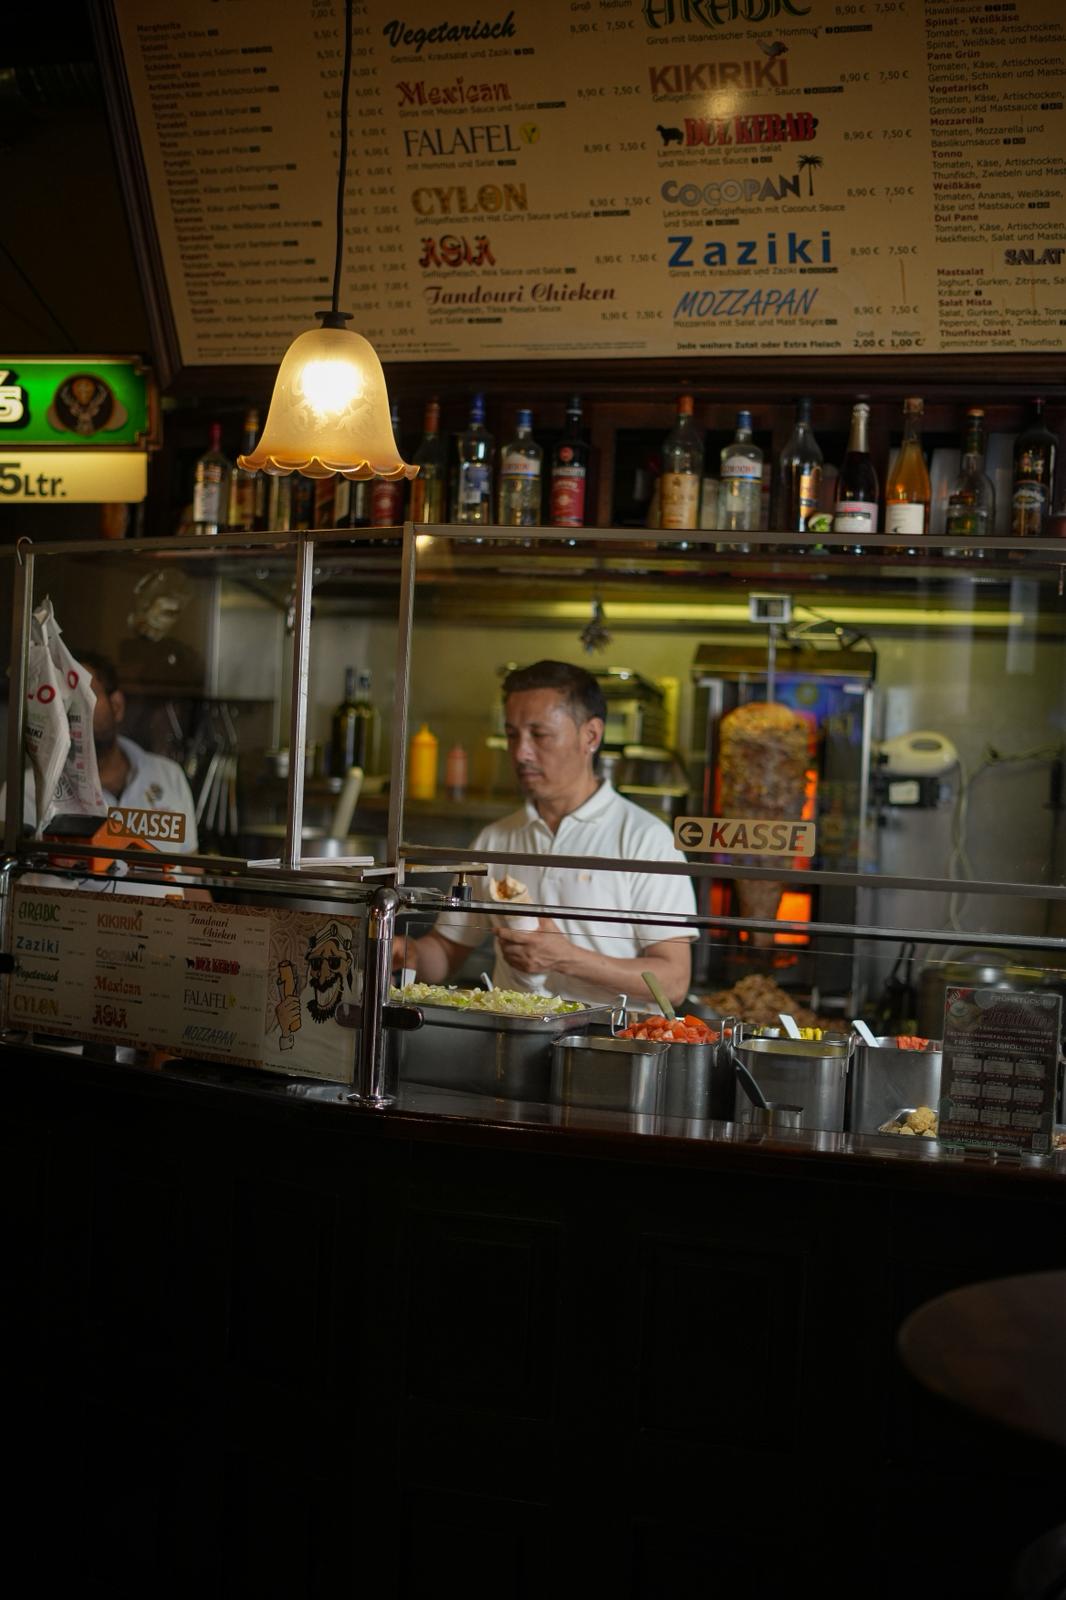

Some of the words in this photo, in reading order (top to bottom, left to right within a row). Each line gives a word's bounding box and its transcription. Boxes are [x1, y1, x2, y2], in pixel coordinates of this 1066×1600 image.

[876, 4, 896, 12] 7,50
[926, 18, 958, 28] Spinat
[970, 14, 1019, 24] Weißkäse
[383, 11, 516, 52] Vegetarisch
[1000, 22, 1062, 34] Artischocken,
[747, 30, 772, 39] Sauce
[1010, 36, 1026, 44] und
[928, 52, 952, 60] Pane
[956, 50, 980, 58] Grün
[1002, 56, 1064, 68] Artischocken,
[650, 58, 788, 94] KIKIRIKI
[880, 72, 900, 81] 7,50
[1016, 69, 1034, 78] und
[396, 76, 512, 107] Mexican
[929, 83, 988, 94] Vegetarisch
[1003, 90, 1064, 100] Artischocken,
[970, 104, 986, 112] und
[990, 102, 1038, 112] Mastsauce
[930, 117, 984, 126] Mozzarella
[734, 112, 818, 144] KEBAB
[976, 125, 1024, 134] Mozzarella
[1027, 124, 1044, 133] und
[866, 131, 874, 140] €
[882, 130, 902, 139] 7,50
[906, 128, 912, 138] €
[404, 124, 521, 157] FALAFEL
[932, 150, 962, 158] Tonno
[982, 170, 1022, 178] Zwiebeln
[1026, 168, 1043, 176] und
[661, 174, 800, 206] COCOPAN
[411, 183, 528, 216] CYLON
[978, 192, 1014, 200] Ananas,
[782, 204, 816, 214] Coconut
[820, 204, 845, 212] Sauce
[958, 202, 975, 210] und
[954, 213, 978, 222] Pane
[992, 233, 1014, 242] Salat
[1018, 232, 1034, 240] und
[668, 231, 832, 268] Zaziki
[888, 246, 909, 256] 7,50
[937, 268, 984, 276] Mastsalat
[425, 283, 524, 305] Tandouri
[531, 282, 616, 302] Chicken
[674, 288, 819, 318] MOZZAPAN
[939, 299, 962, 307] Salat
[966, 298, 992, 306] Mista
[940, 329, 1011, 338] Thunfischsalat
[126, 811, 184, 839] KASSE
[710, 822, 806, 852] KASSE
[18, 902, 61, 922] ARABIC
[97, 914, 142, 932] KIKIRIKI
[16, 936, 60, 954] Zaziki
[184, 988, 228, 1010] FALAFEL
